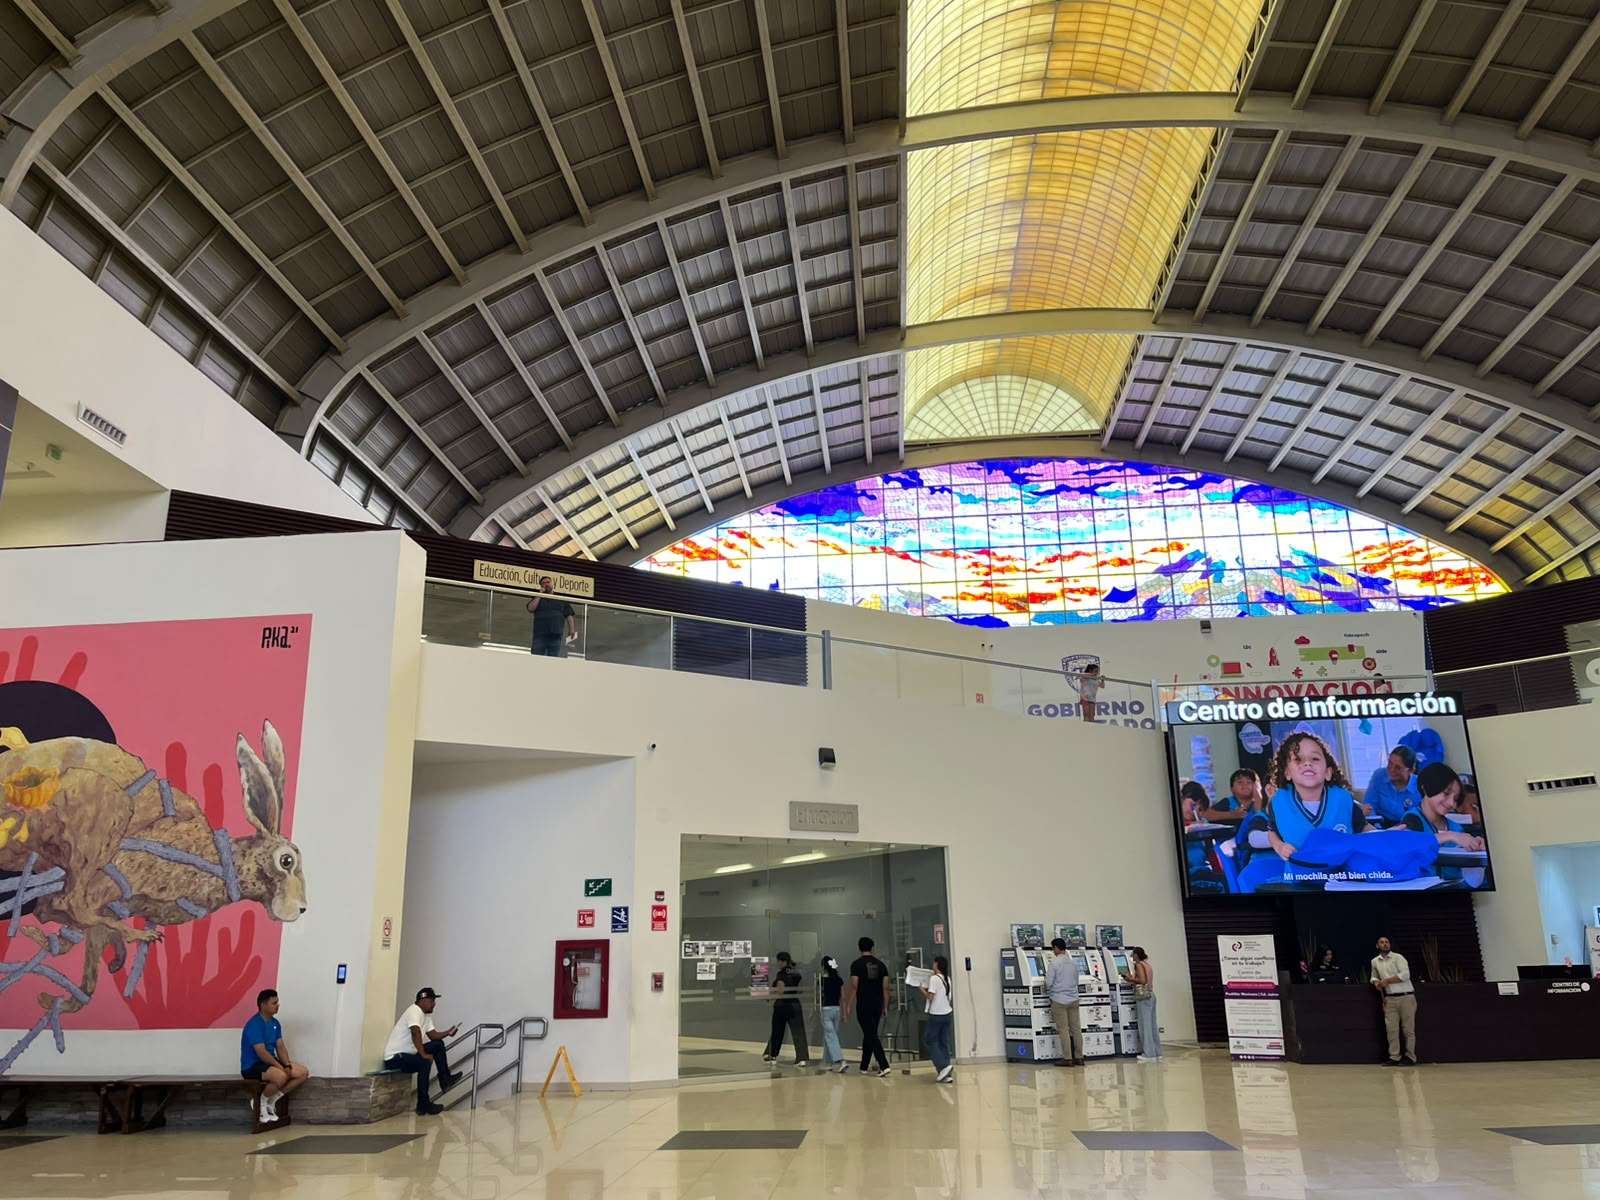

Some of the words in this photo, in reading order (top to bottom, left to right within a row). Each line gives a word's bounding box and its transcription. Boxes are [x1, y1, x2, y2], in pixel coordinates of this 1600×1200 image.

[479, 562, 522, 585] Educación,
[559, 575, 590, 593] Deporte
[1213, 681, 1393, 700] NNOVACION
[1027, 700, 1145, 718] GOBIRNO
[1178, 700, 1264, 722] Centro
[1267, 697, 1300, 719] de
[1303, 691, 1457, 718] información
[1283, 872, 1294, 881] Mi
[1295, 871, 1328, 880] mochila
[1329, 871, 1347, 880] está
[1348, 871, 1367, 880] bien
[1368, 871, 1394, 880] chida.
